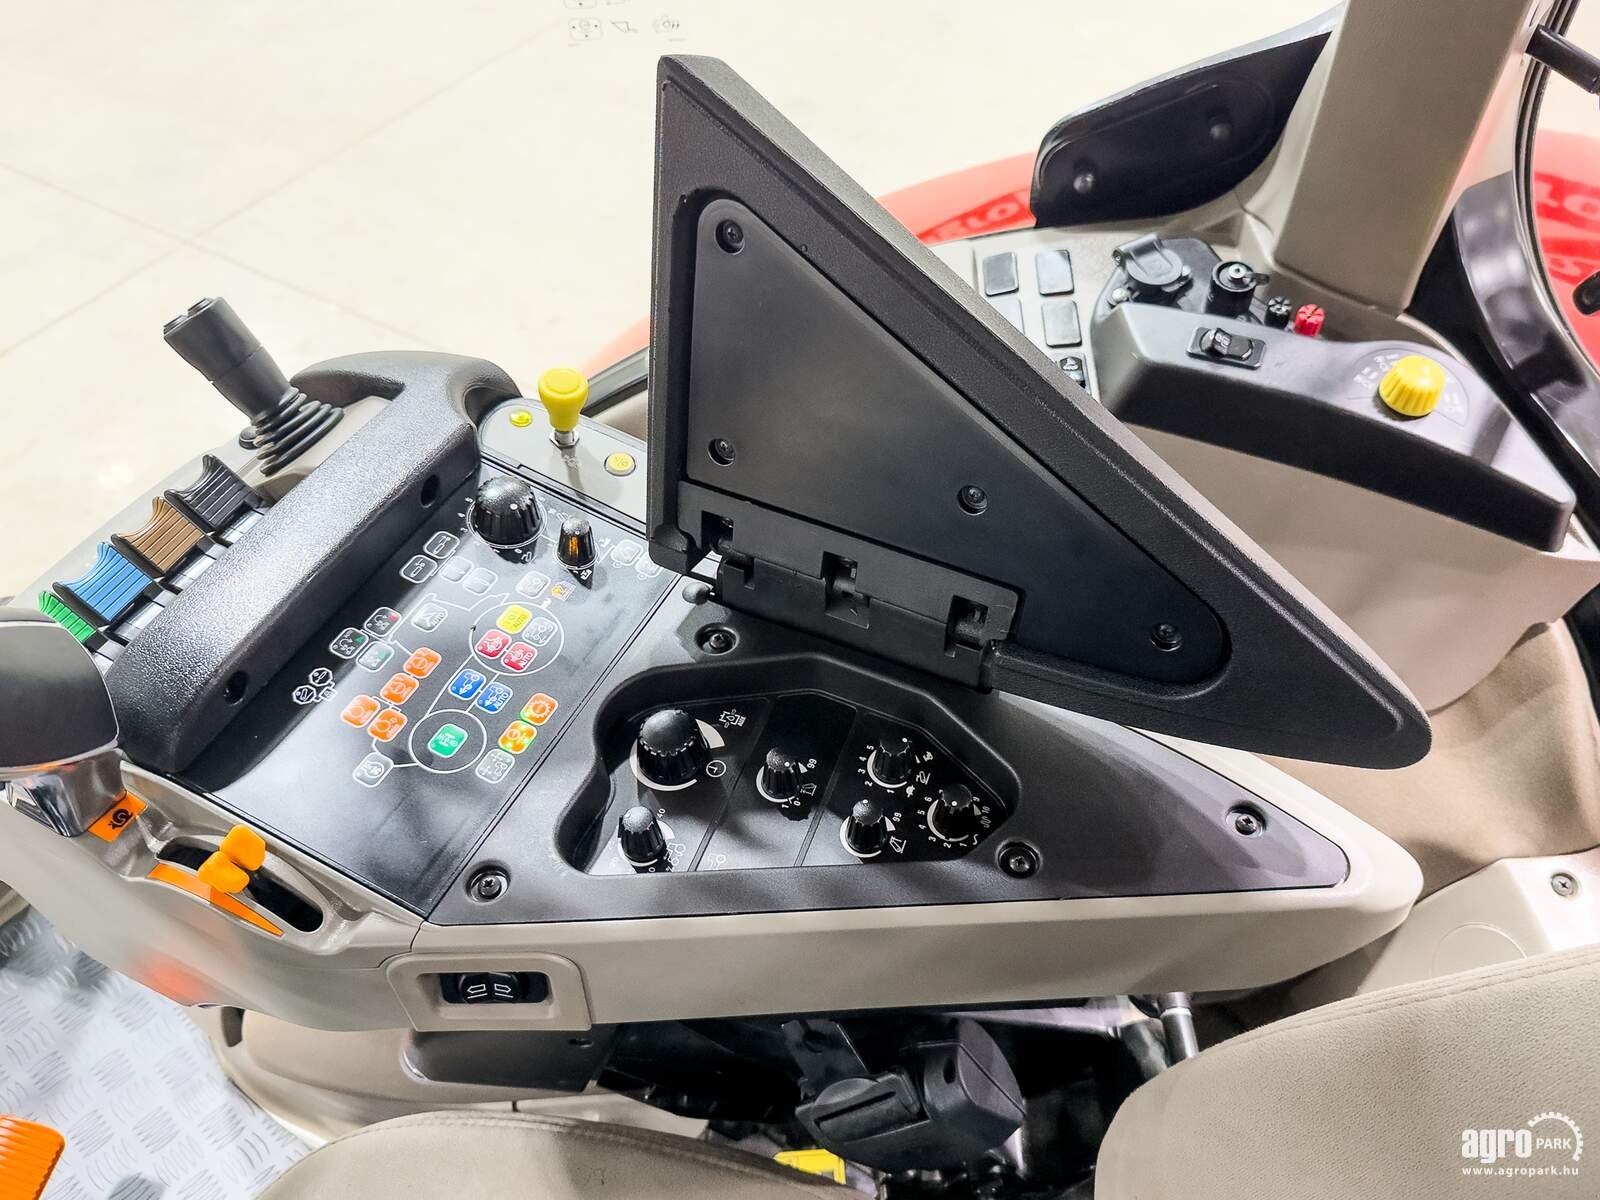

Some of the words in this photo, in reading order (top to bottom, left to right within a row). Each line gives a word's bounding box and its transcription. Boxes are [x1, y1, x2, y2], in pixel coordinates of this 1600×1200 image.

[518, 652, 533, 668] AUTO
[495, 692, 509, 709] AUTO
[806, 758, 817, 769] 99
[657, 808, 666, 818] 40
[892, 812, 902, 822] 99
